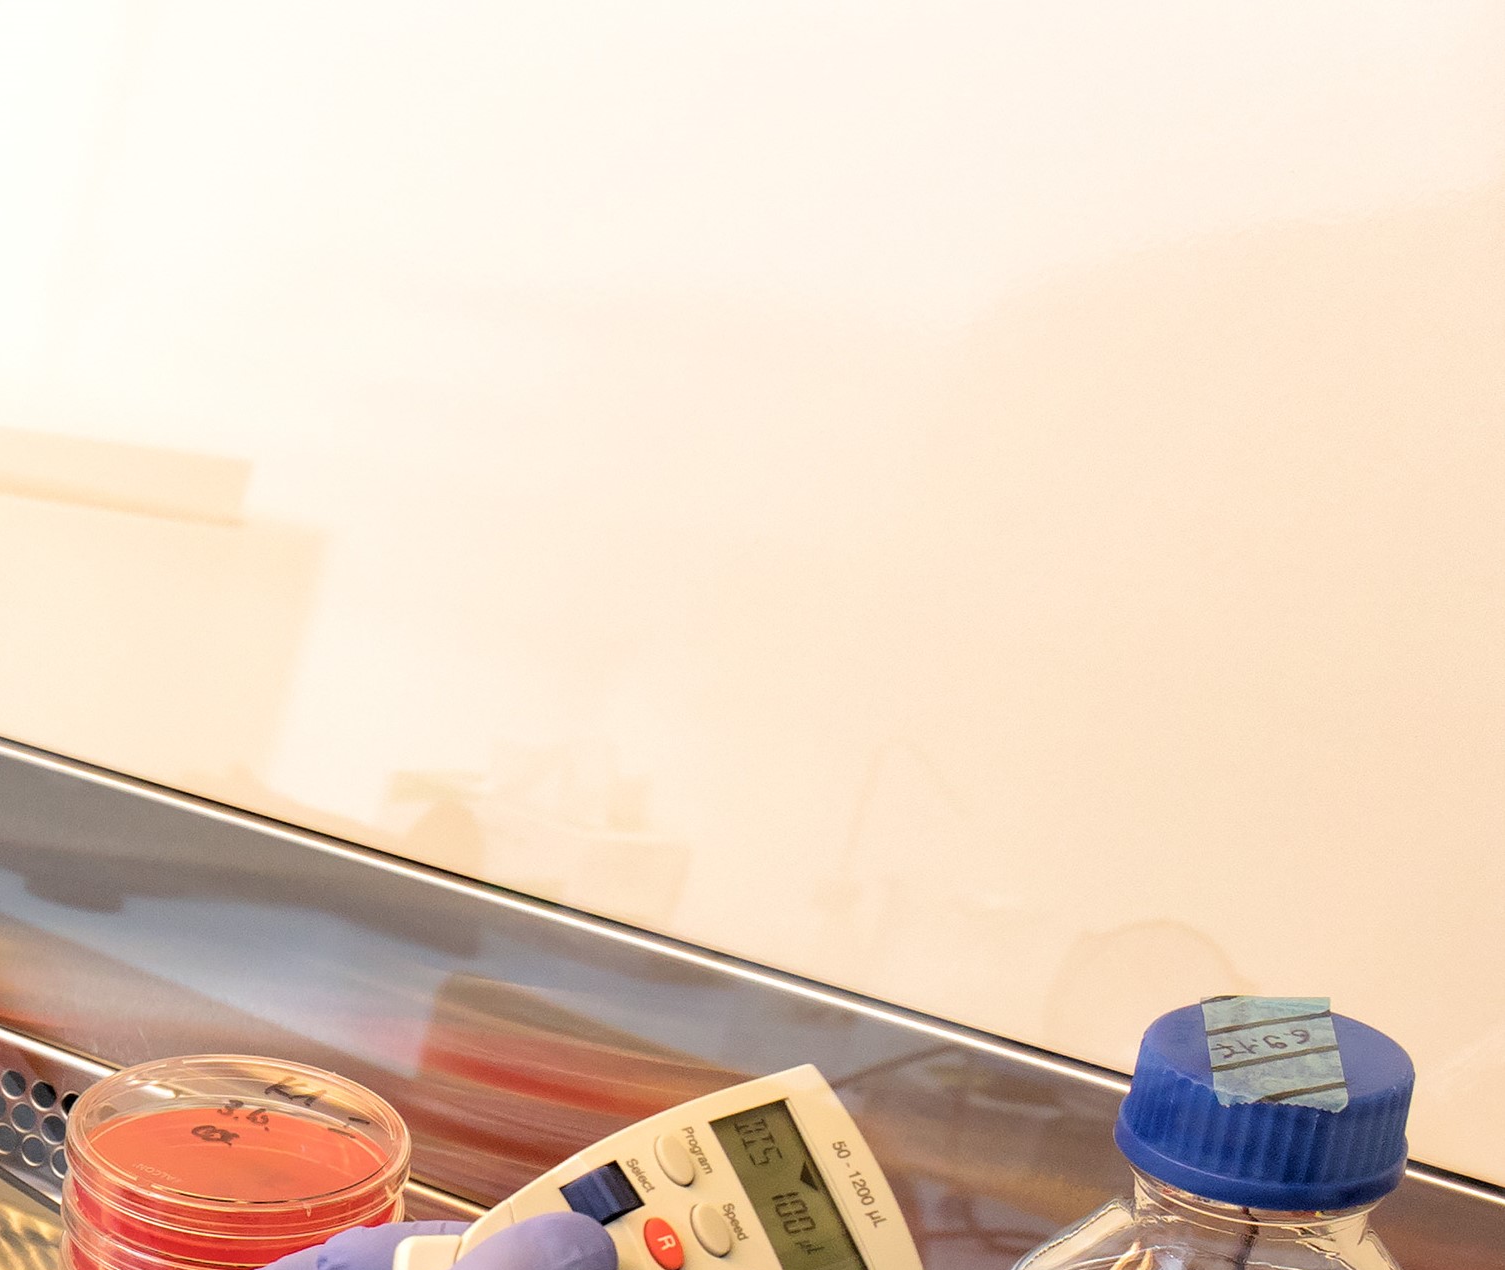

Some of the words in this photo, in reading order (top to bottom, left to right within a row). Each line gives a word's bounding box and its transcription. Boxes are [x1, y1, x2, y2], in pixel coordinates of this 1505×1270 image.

[681, 1126, 714, 1175] Program
[625, 1158, 656, 1193] Select
[832, 1140, 852, 1160] 50
[848, 1170, 876, 1206] 1200
[722, 1202, 750, 1242] Speed
[771, 1191, 816, 1235] 100
[657, 1234, 677, 1251] R
